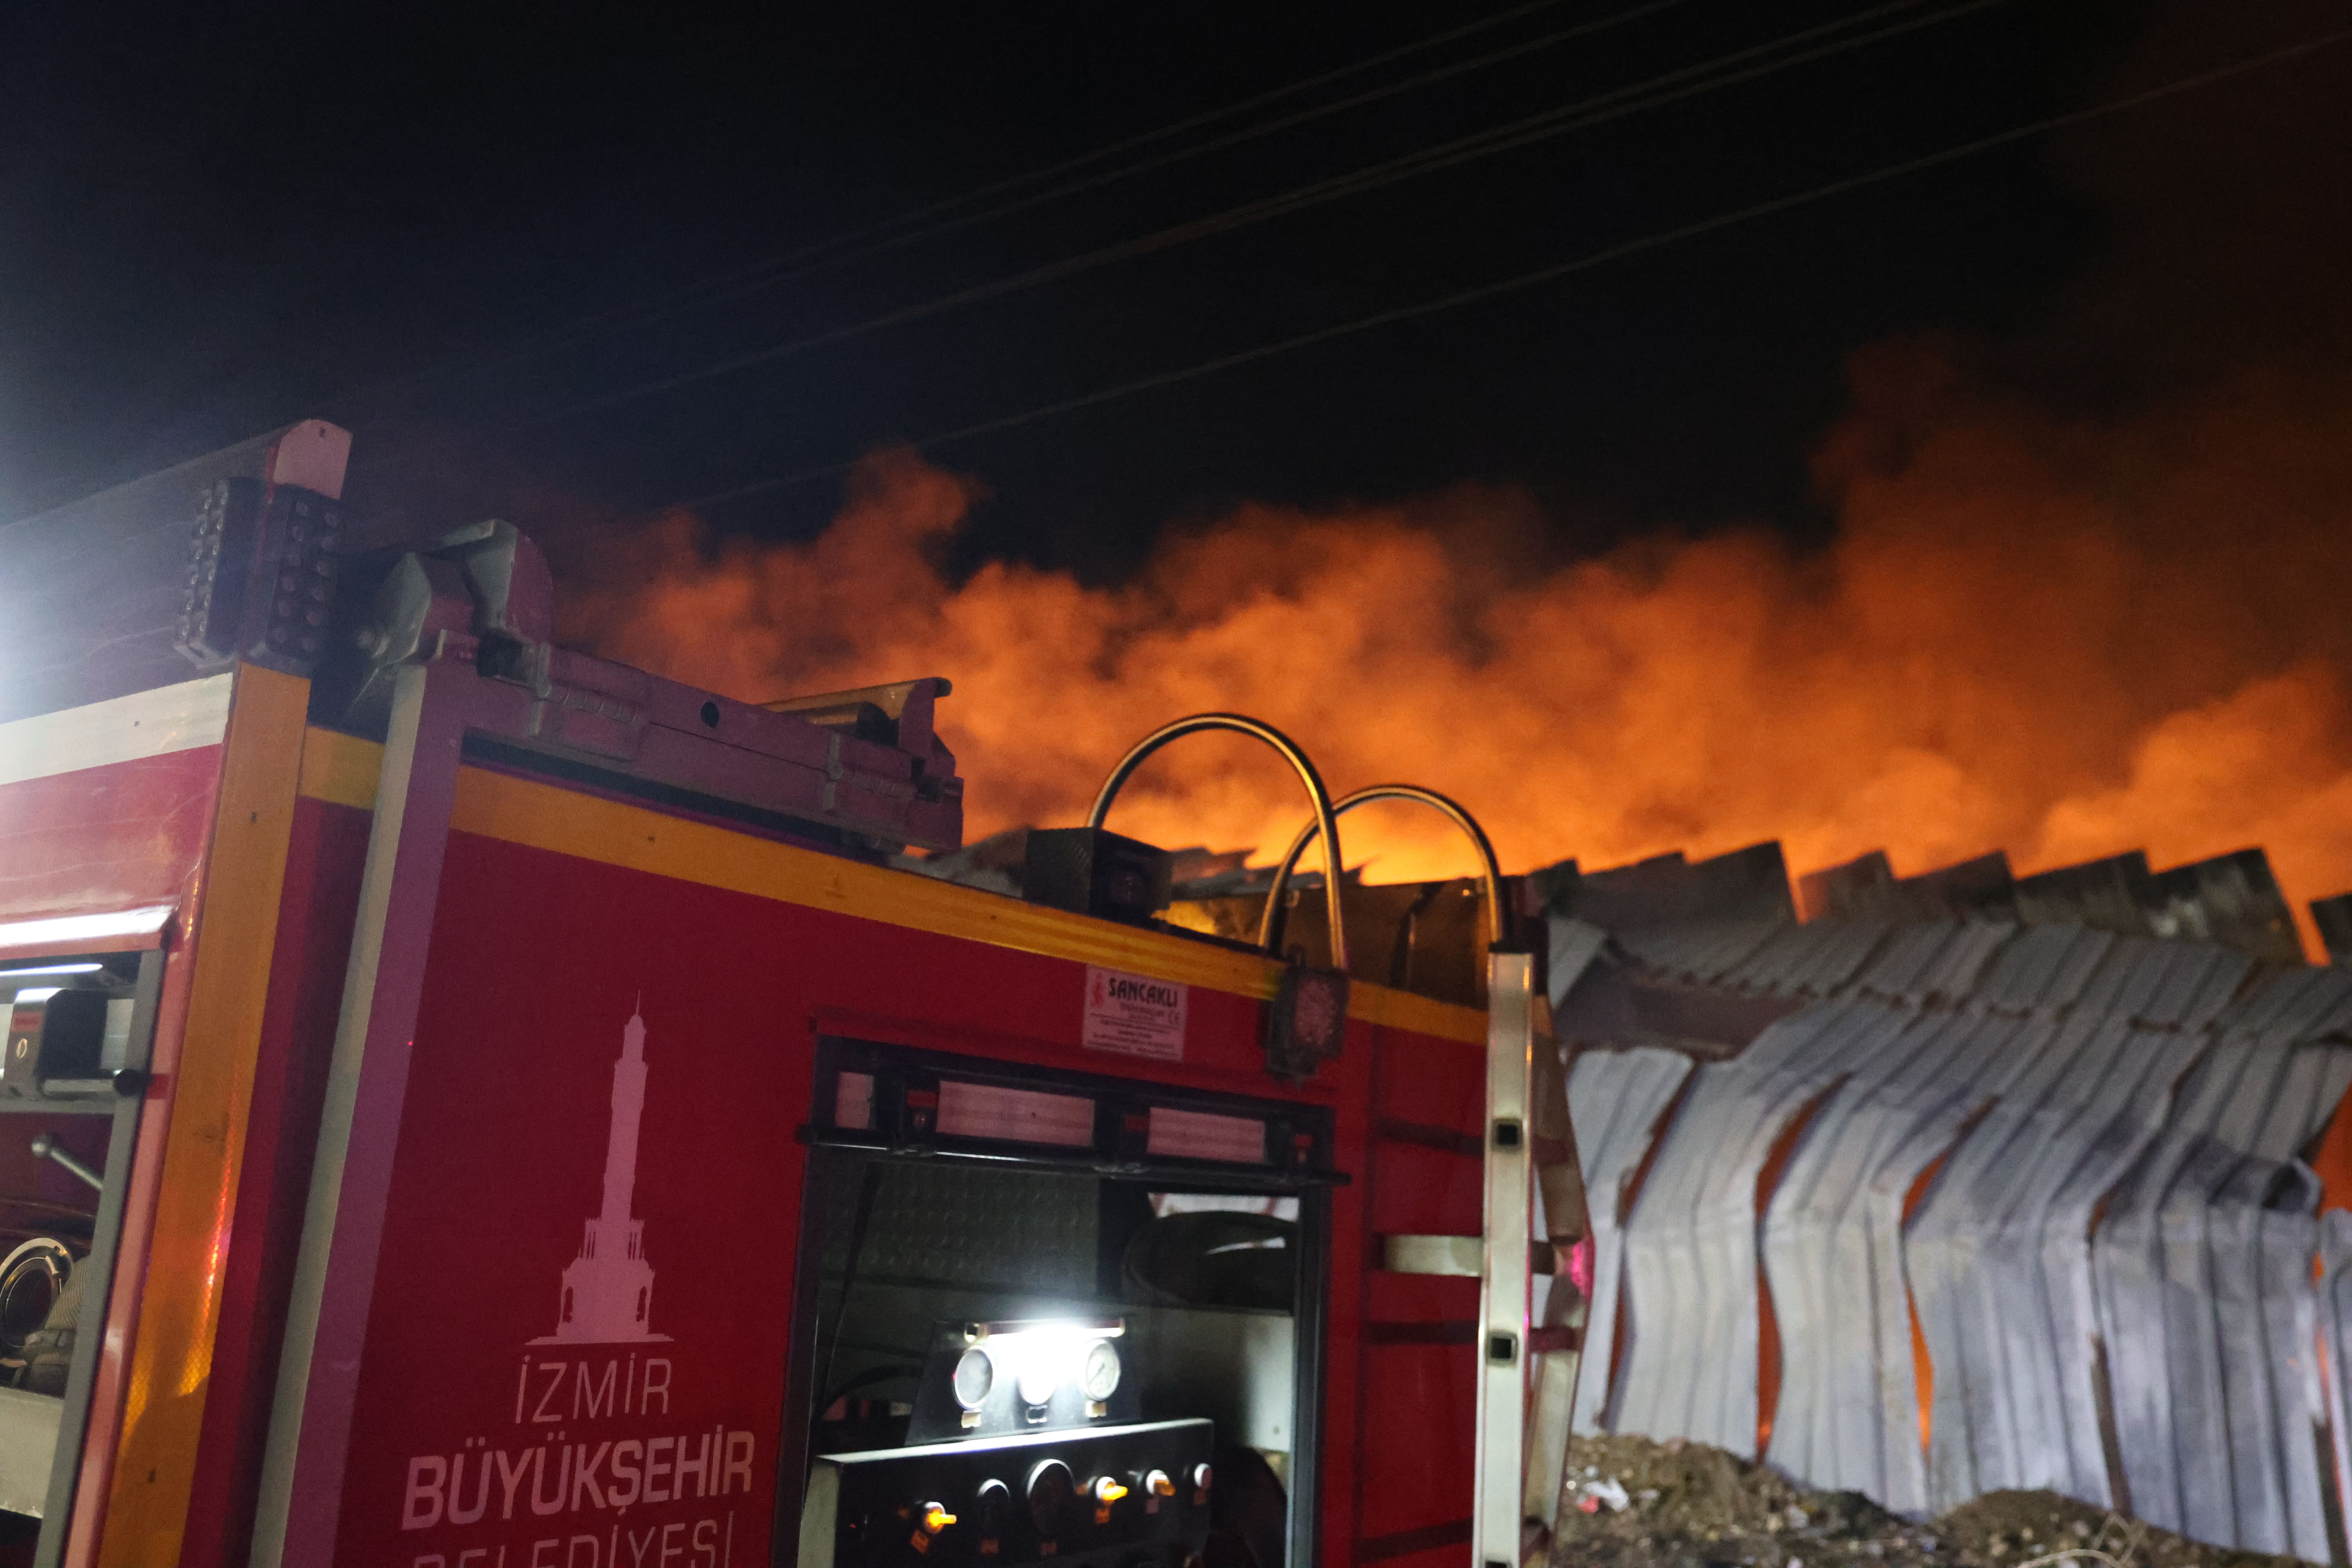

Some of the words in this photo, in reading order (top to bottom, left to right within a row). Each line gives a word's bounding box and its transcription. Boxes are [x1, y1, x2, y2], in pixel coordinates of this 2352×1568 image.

[1109, 978, 1177, 1007] SANCAKLI
[514, 1352, 672, 1424] İZMİR
[401, 1425, 755, 1530] BÜYÜKŞEHİR
